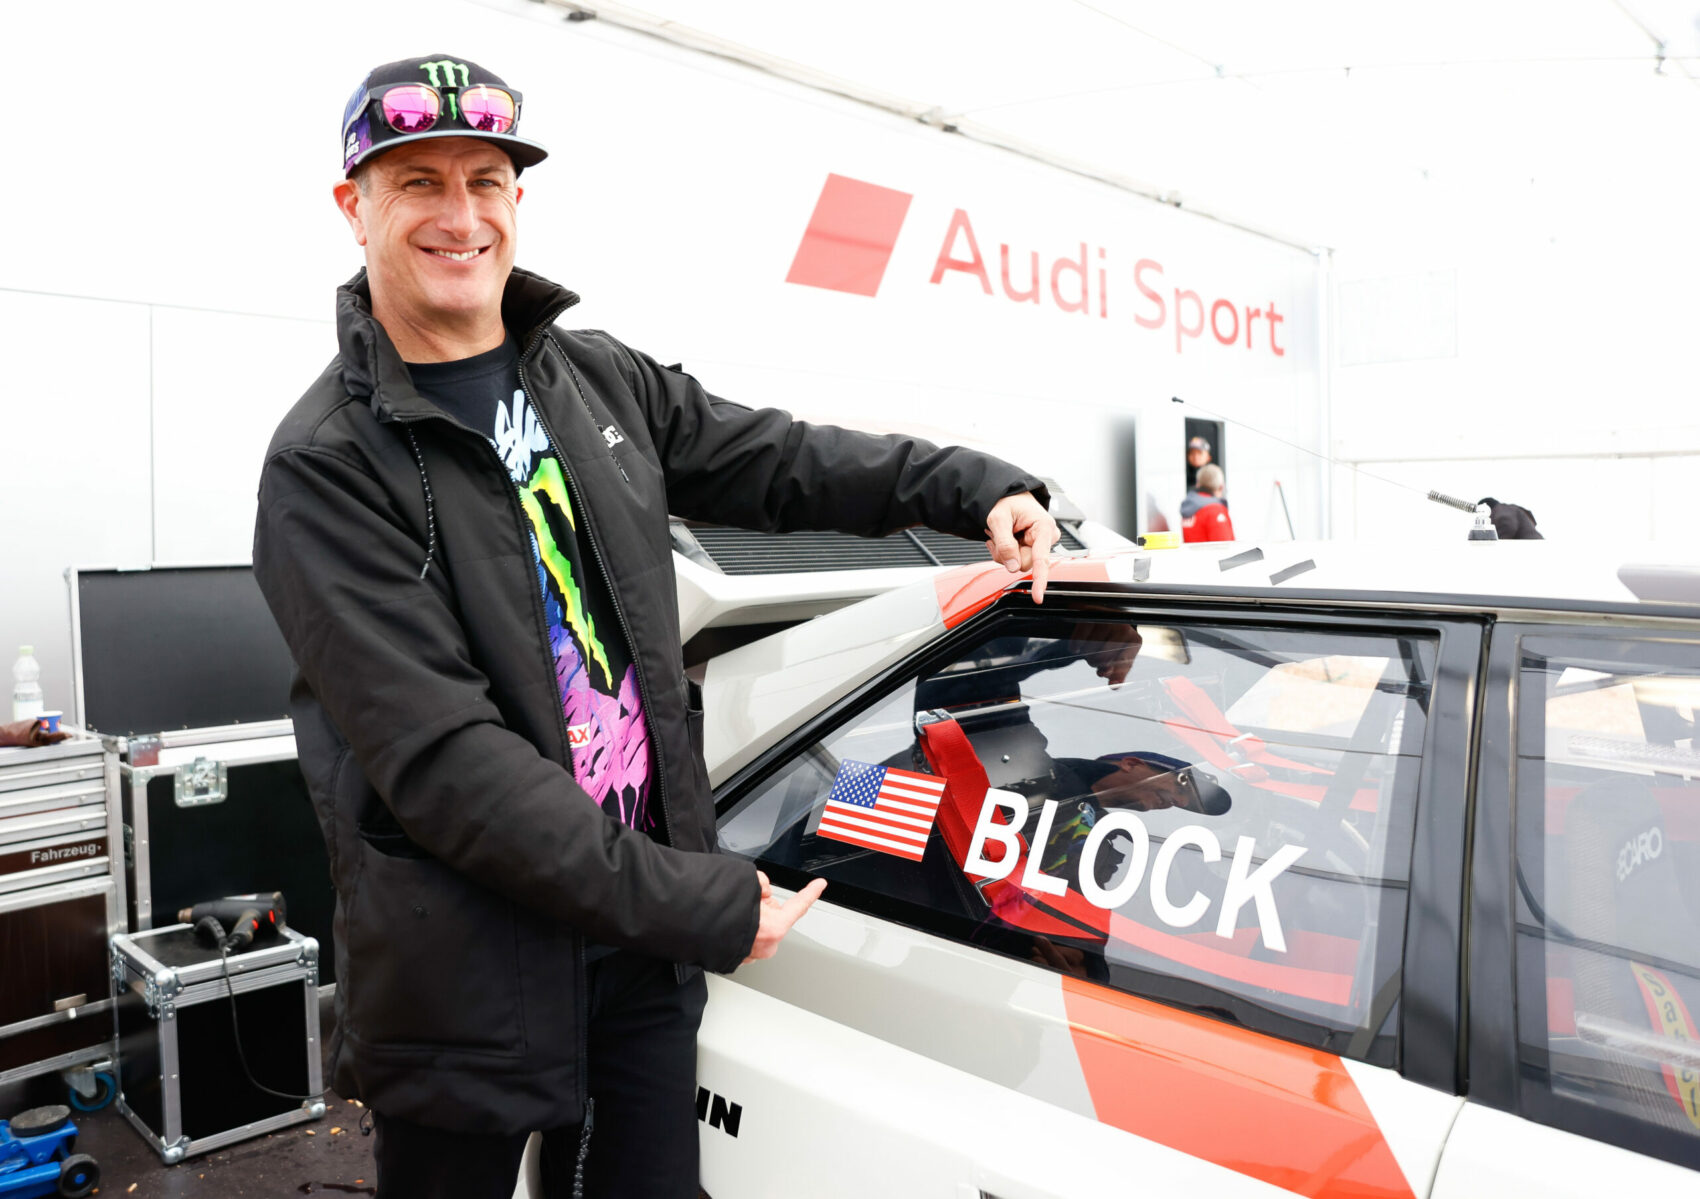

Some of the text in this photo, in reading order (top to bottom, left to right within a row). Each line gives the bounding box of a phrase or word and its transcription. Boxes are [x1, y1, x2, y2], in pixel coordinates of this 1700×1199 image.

[929, 207, 1285, 357] Audi Sport
[963, 786, 1309, 953] BLOCK
